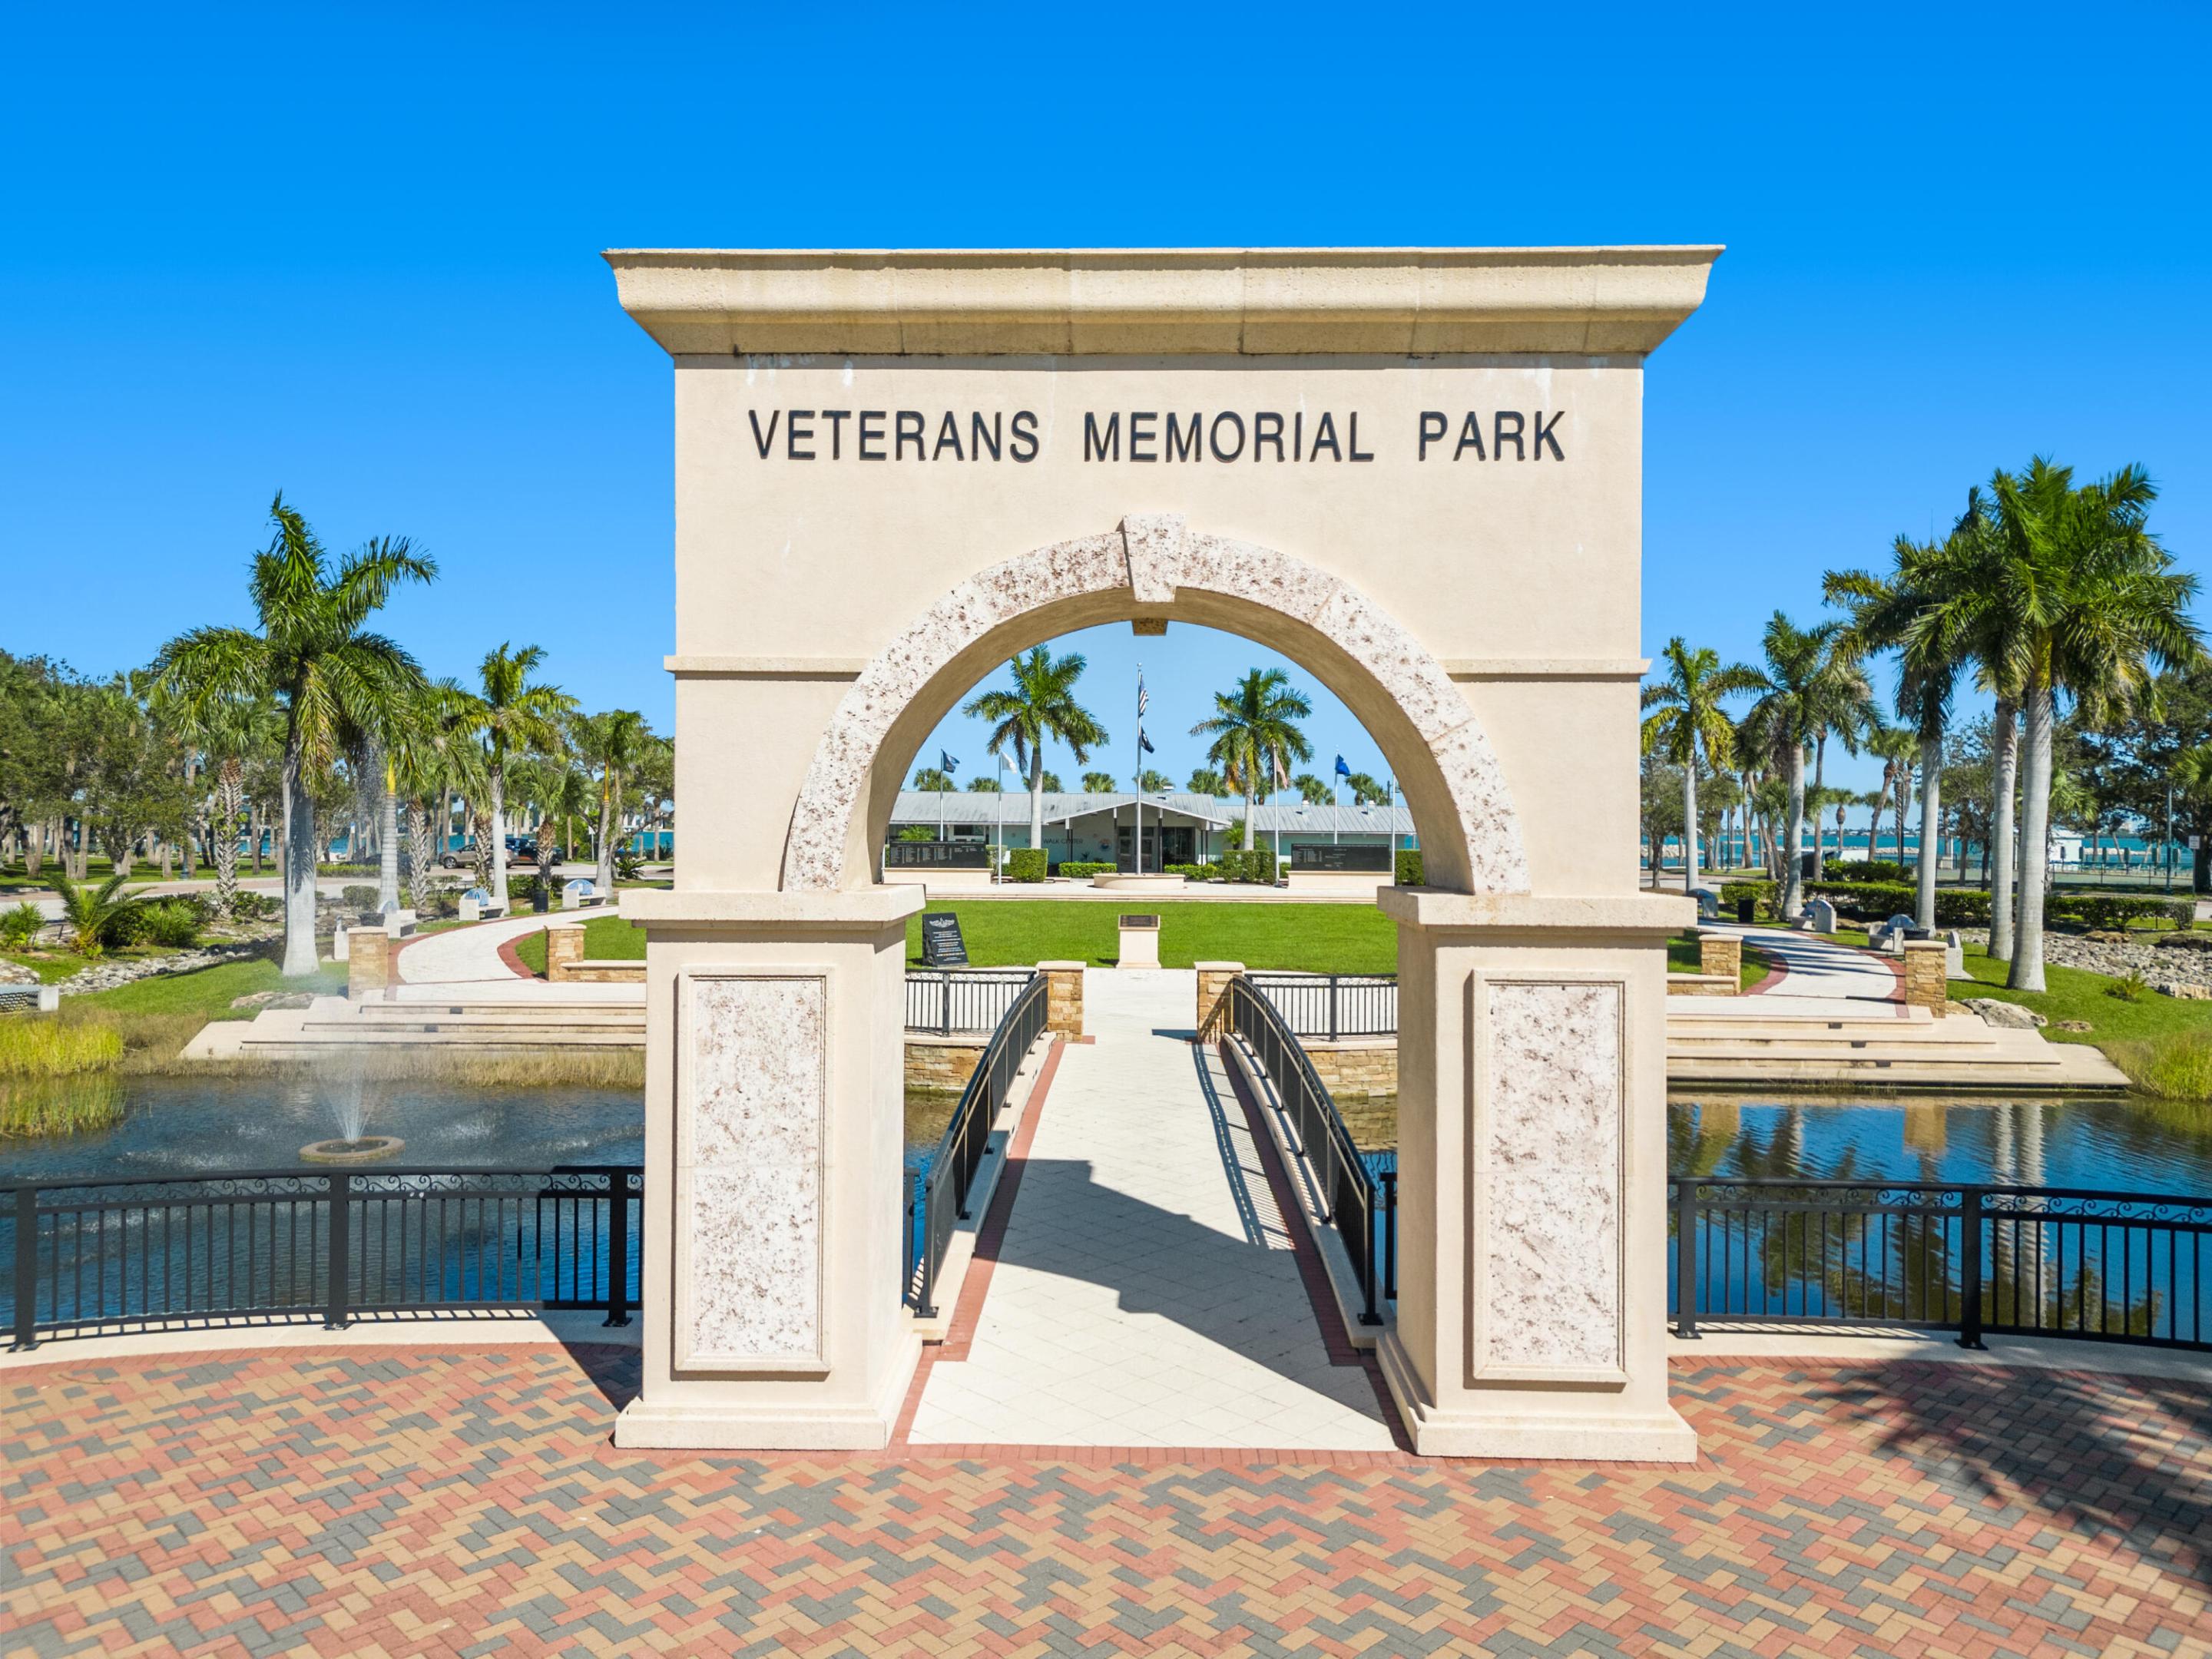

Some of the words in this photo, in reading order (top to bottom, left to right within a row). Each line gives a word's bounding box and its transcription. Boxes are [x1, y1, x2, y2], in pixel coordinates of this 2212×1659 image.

[748, 410, 1039, 462] VETERANS
[1084, 412, 1374, 462] MEMORIAL
[1419, 411, 1566, 462] PARK
